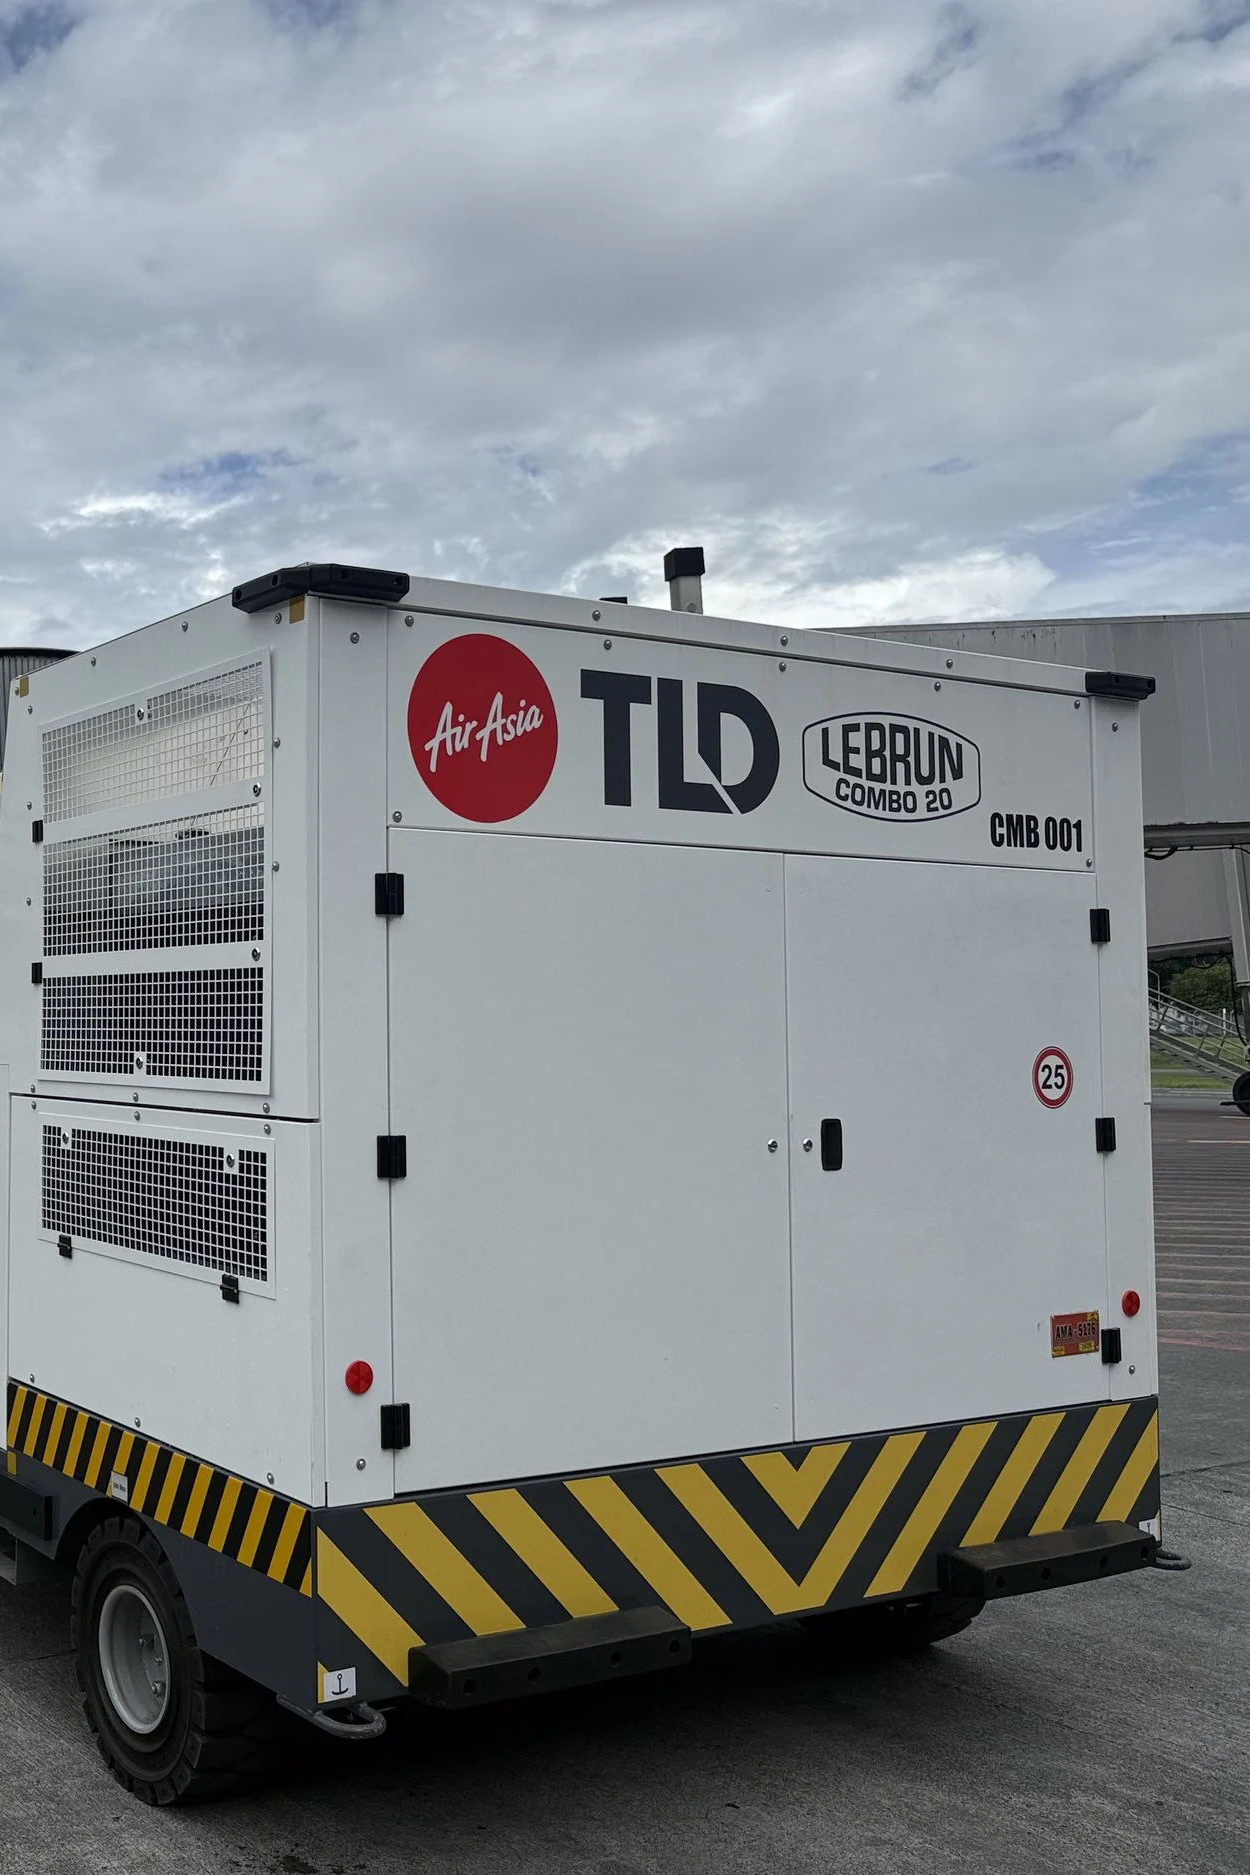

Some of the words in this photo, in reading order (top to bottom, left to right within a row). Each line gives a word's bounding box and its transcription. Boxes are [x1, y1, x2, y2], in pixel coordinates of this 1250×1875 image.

[580, 668, 780, 815] TLD
[821, 722, 964, 787] LEBRUN
[835, 777, 918, 814] COMBO
[925, 787, 953, 813] 20
[990, 812, 1039, 848] CMB
[1044, 816, 1083, 852] 001
[1041, 1064, 1065, 1090] 25
